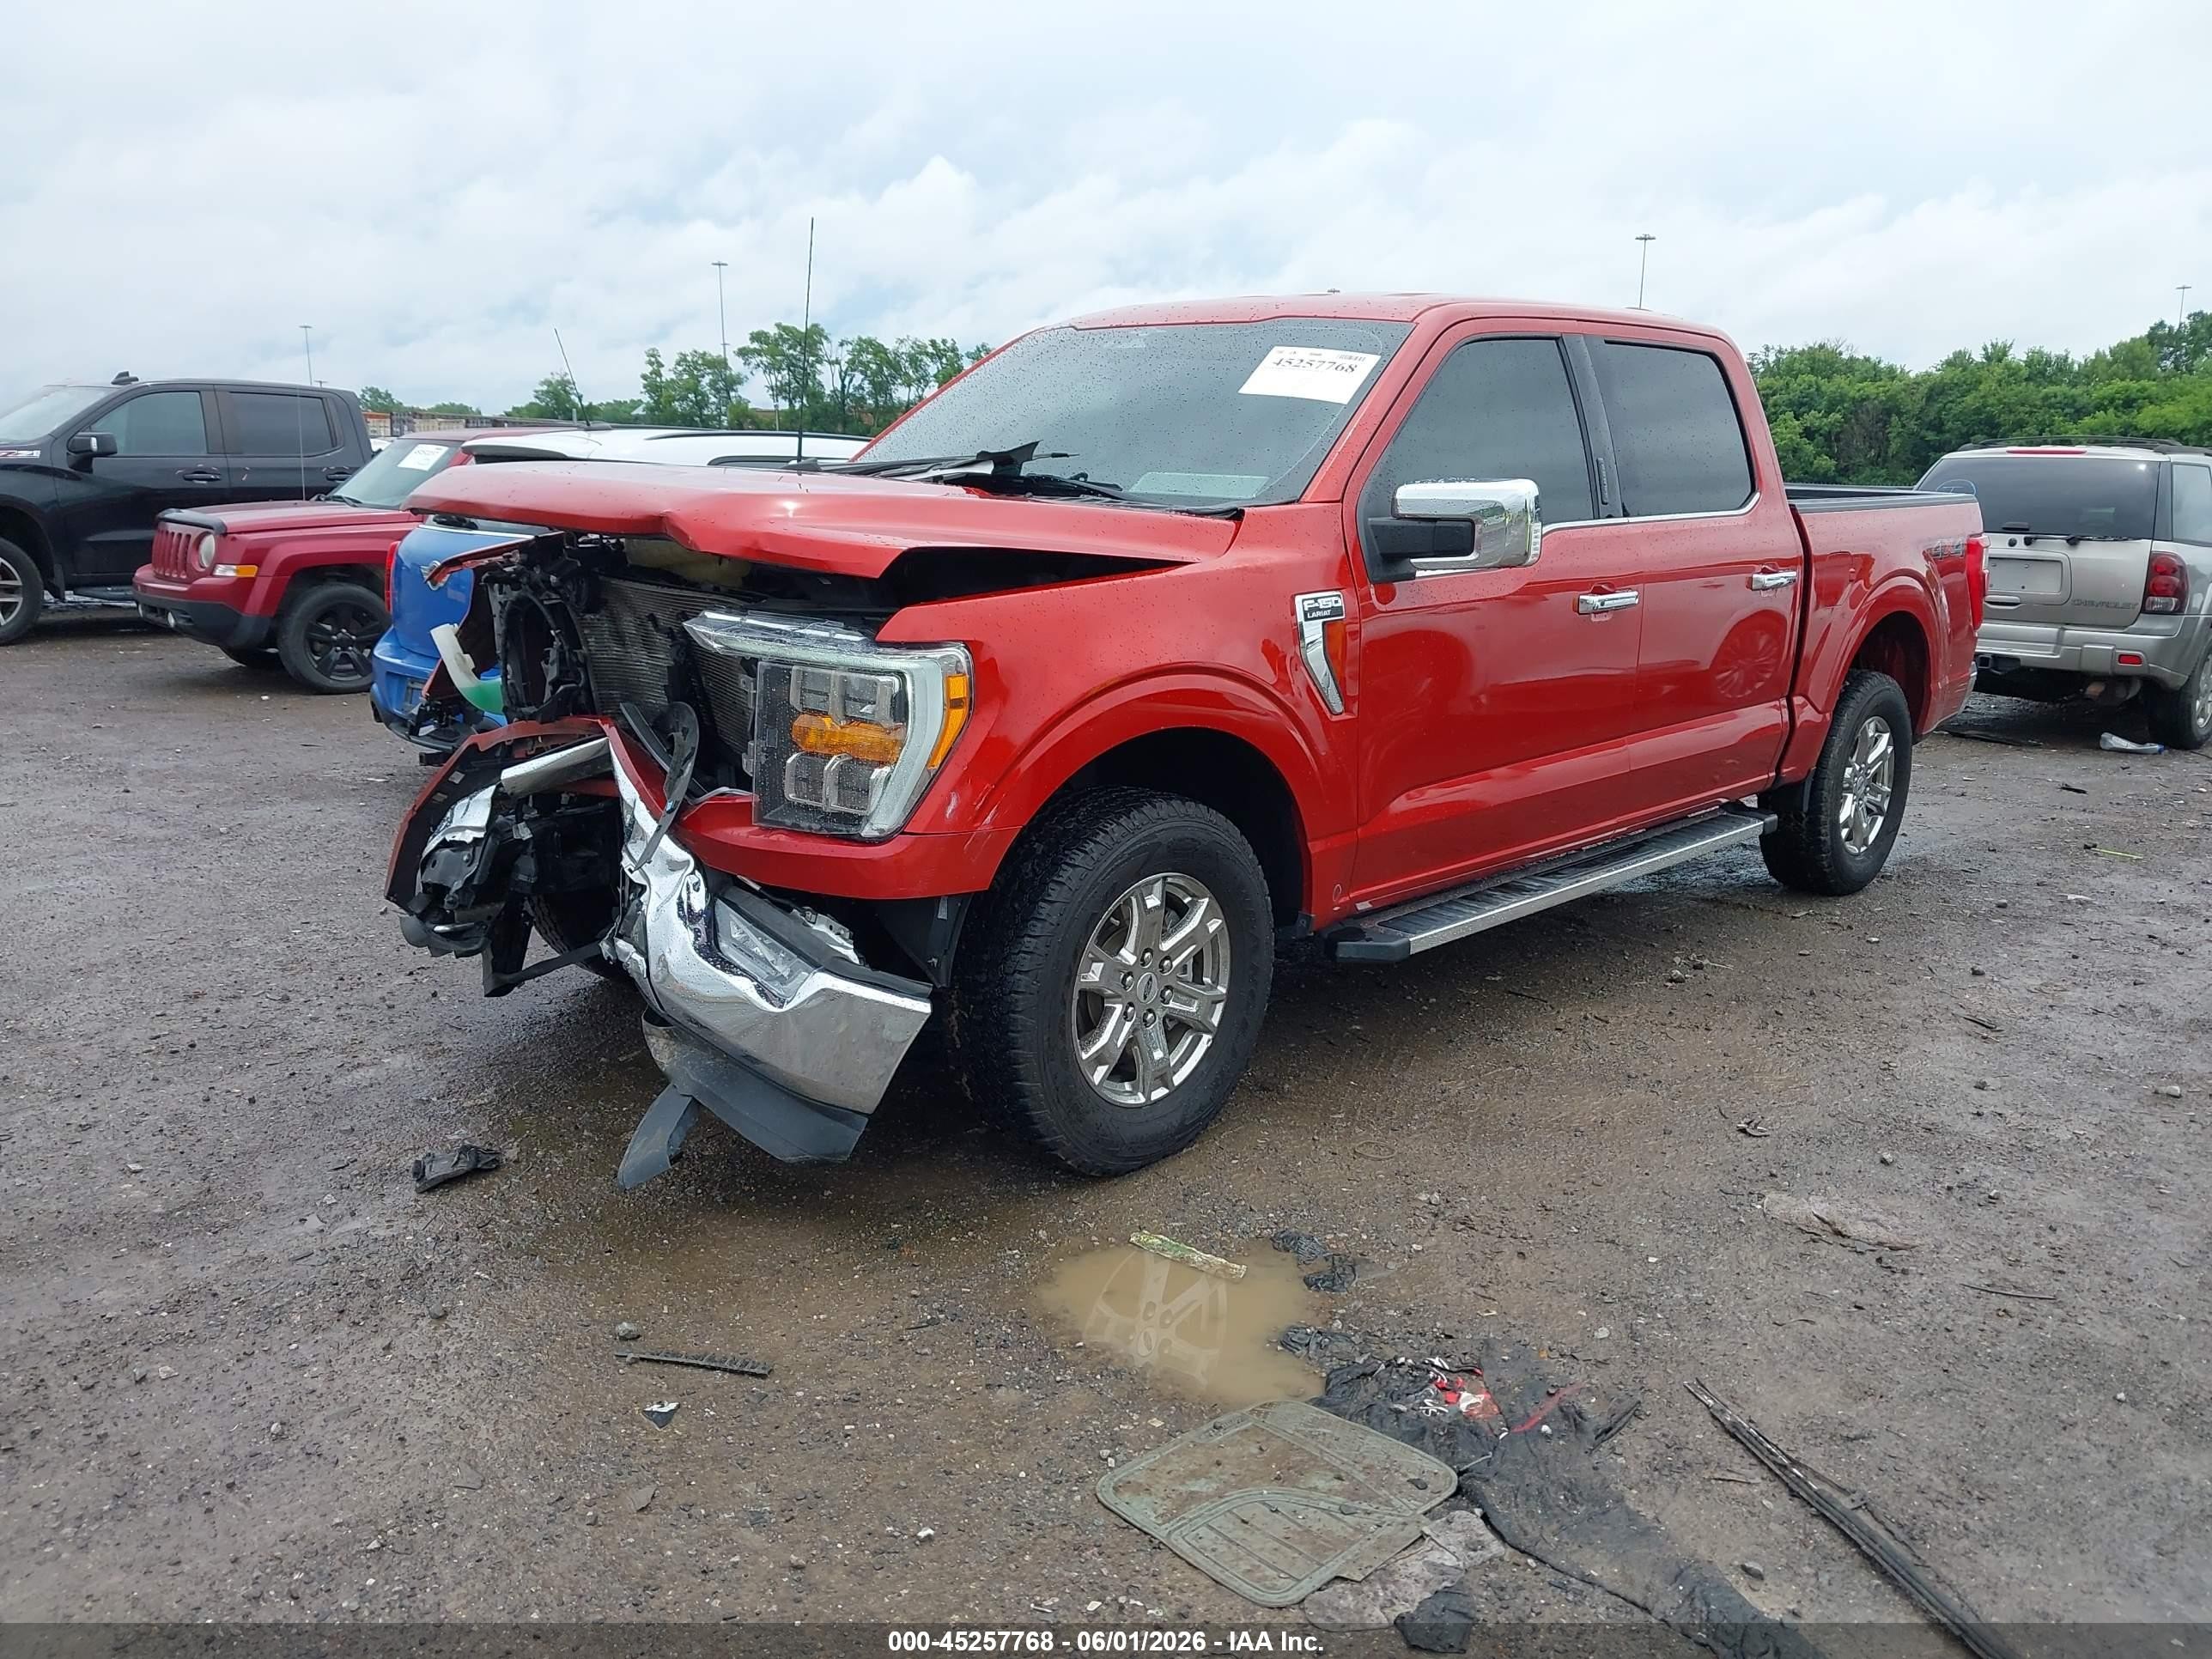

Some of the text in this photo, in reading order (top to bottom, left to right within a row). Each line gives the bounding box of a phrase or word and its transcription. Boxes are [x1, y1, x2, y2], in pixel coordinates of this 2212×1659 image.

[1273, 357, 1358, 373] 45257768
[1304, 596, 1342, 611] F-150
[2070, 599, 2139, 610] CHEVROLET
[1307, 609, 1331, 618] LARIAT
